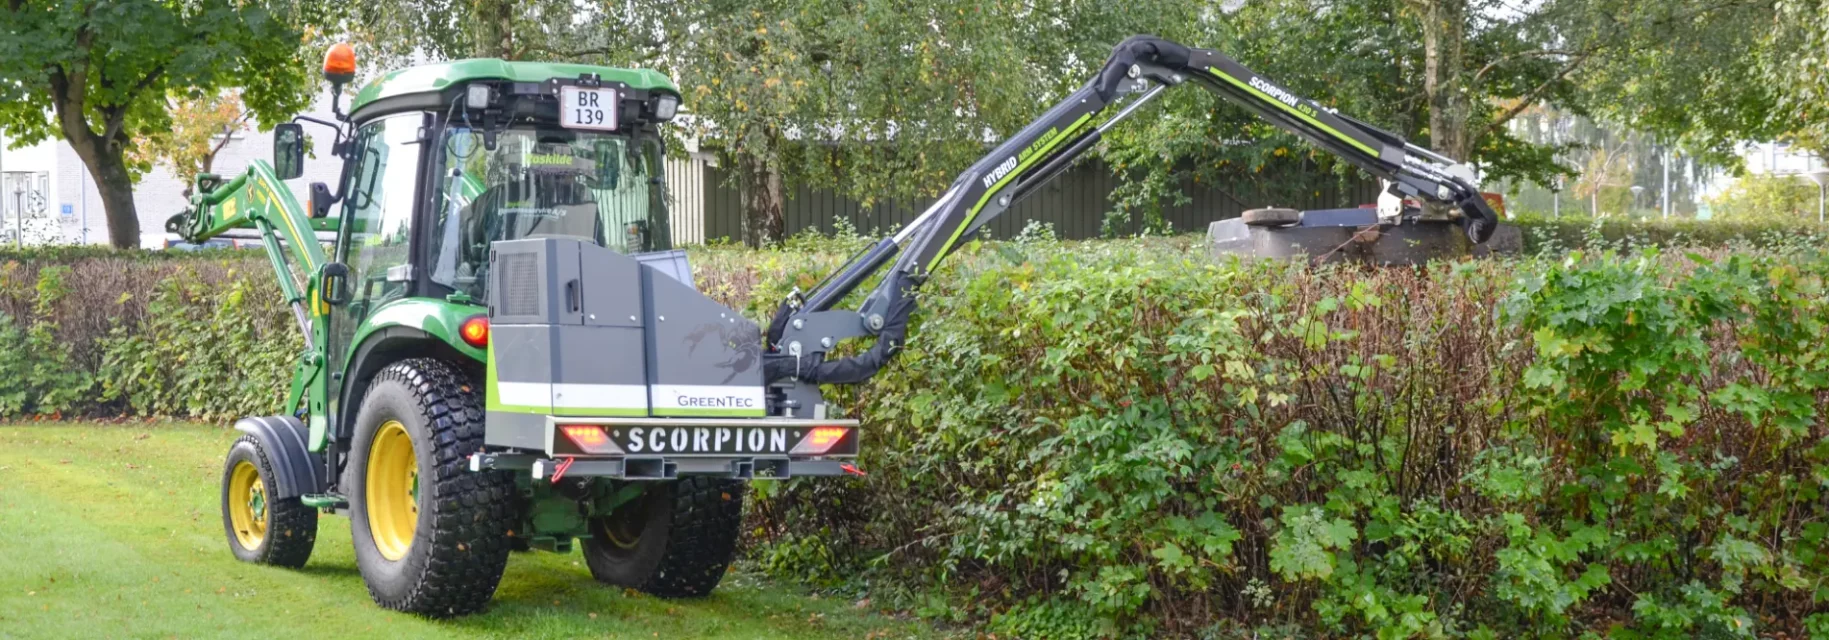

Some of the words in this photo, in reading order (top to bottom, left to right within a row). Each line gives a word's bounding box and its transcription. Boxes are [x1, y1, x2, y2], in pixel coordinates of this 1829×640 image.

[578, 91, 600, 108] BR
[1248, 76, 1299, 107] SCORPION
[575, 108, 604, 125] 139
[982, 156, 1018, 189] HYBRID
[1018, 146, 1034, 163] ARM
[1032, 126, 1058, 151] SYSTEM
[627, 426, 786, 453] SCORPION
